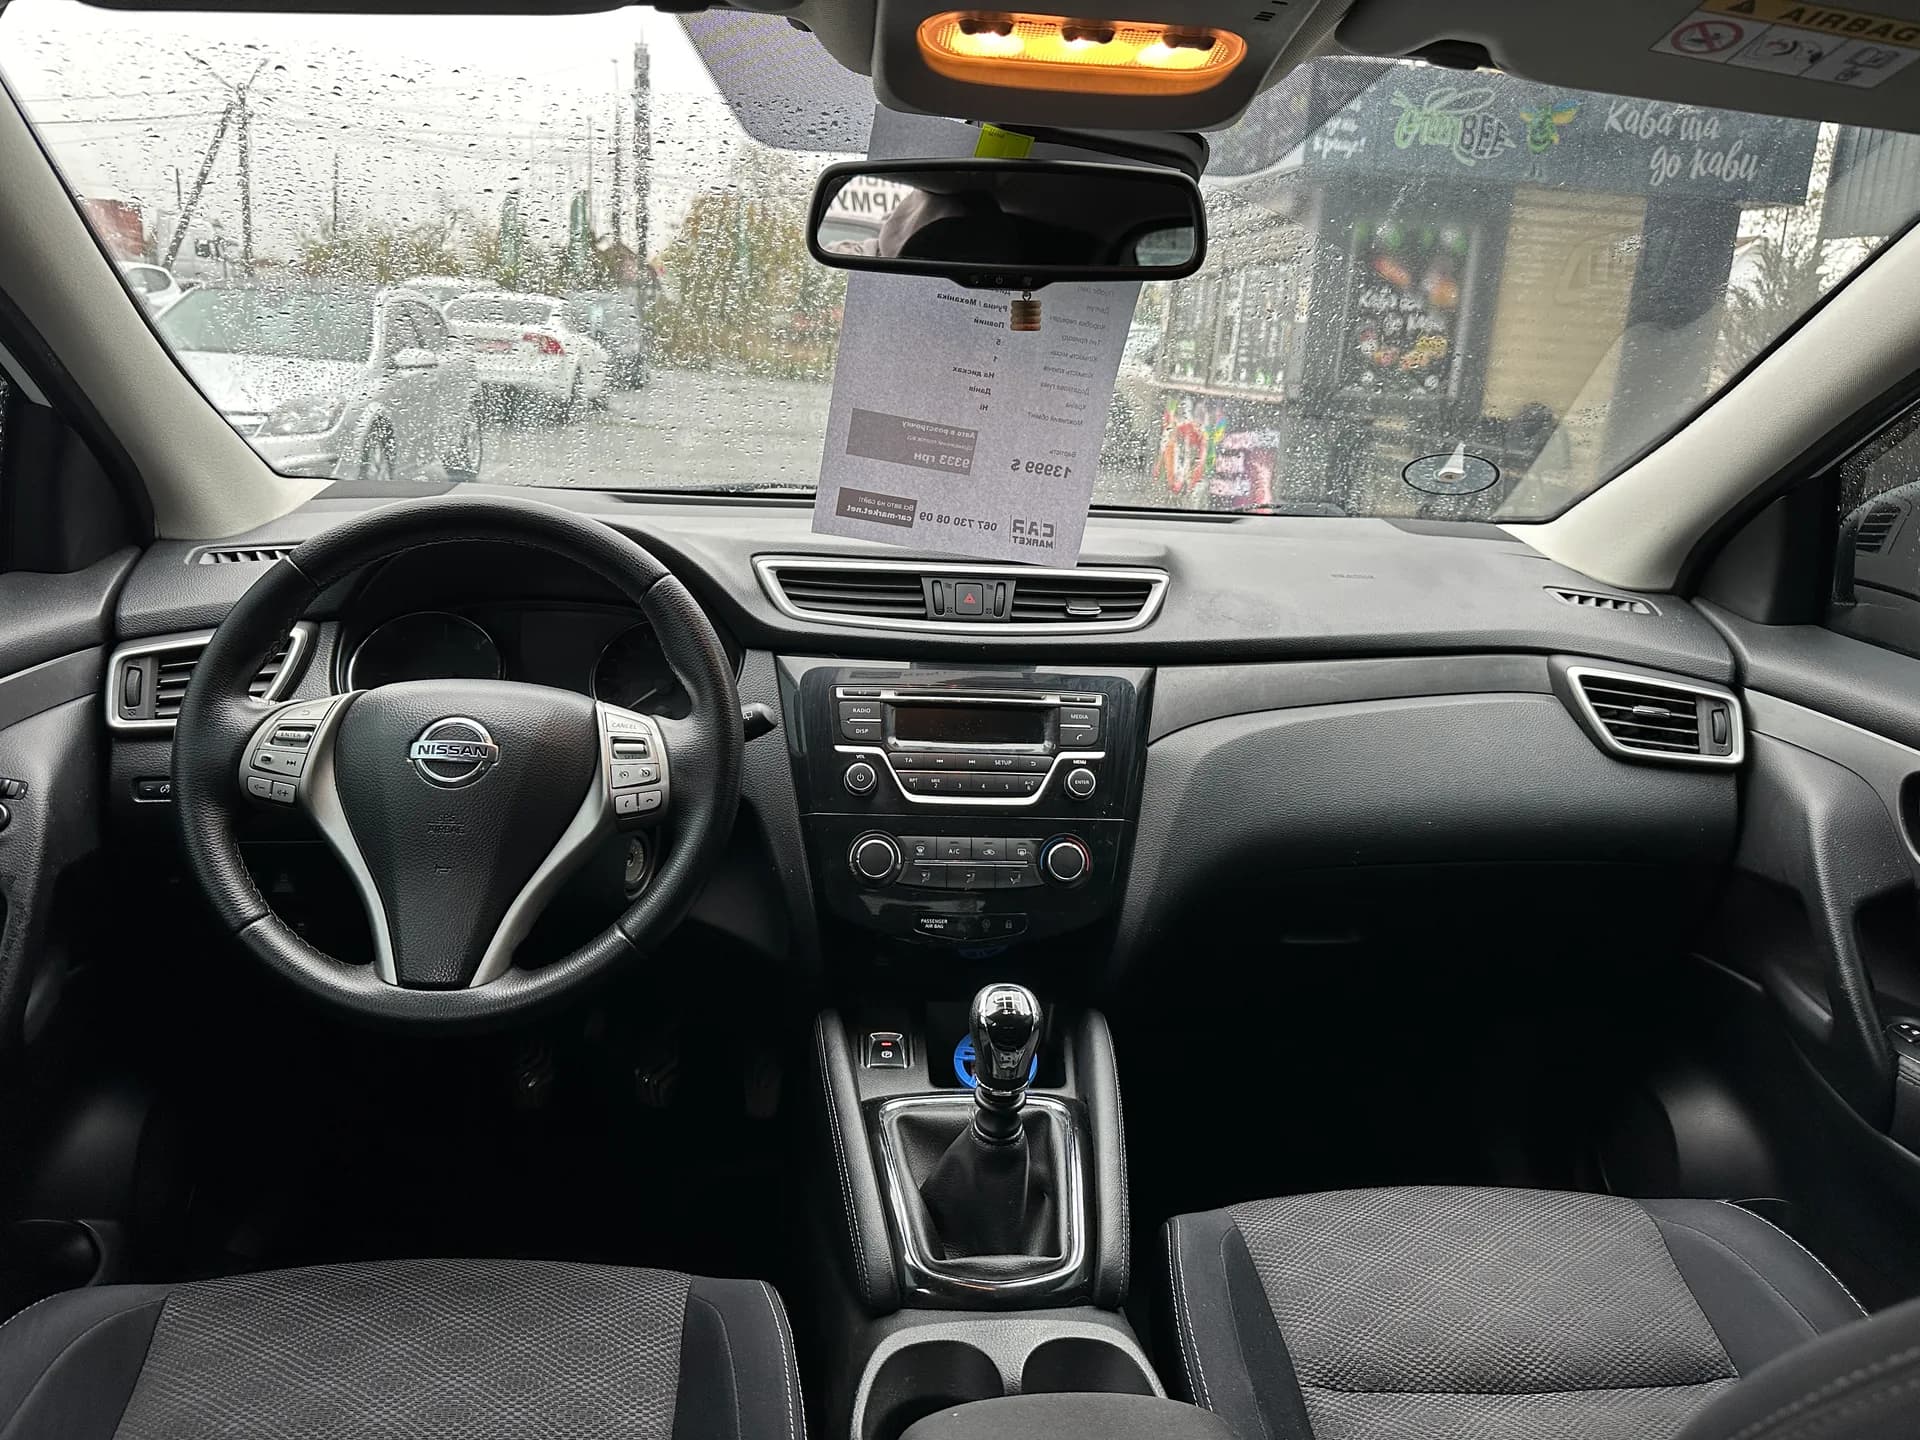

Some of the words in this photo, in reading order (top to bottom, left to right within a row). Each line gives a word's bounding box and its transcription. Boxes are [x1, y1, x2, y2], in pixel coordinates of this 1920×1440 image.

[1779, 6, 1920, 42] AIRBAG
[416, 744, 489, 758] NISSAN
[948, 848, 960, 856] A/C
